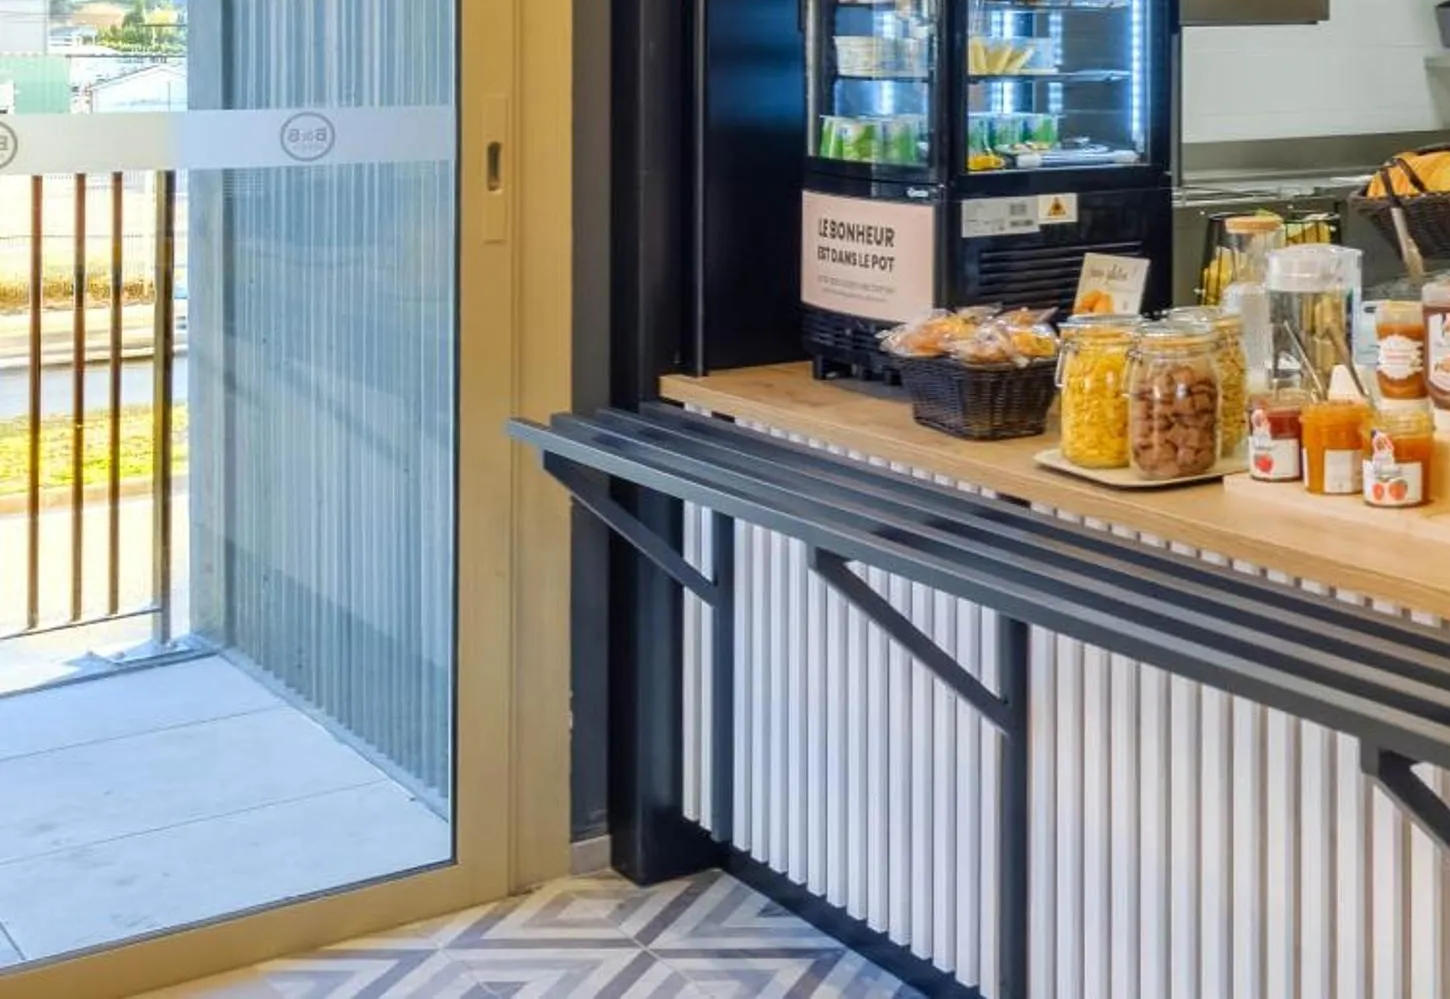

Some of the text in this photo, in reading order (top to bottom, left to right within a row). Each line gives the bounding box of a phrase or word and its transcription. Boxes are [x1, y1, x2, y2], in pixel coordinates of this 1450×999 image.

[818, 217, 896, 248] LE BONHEUR
[817, 245, 895, 273] EST DANS LE POT
